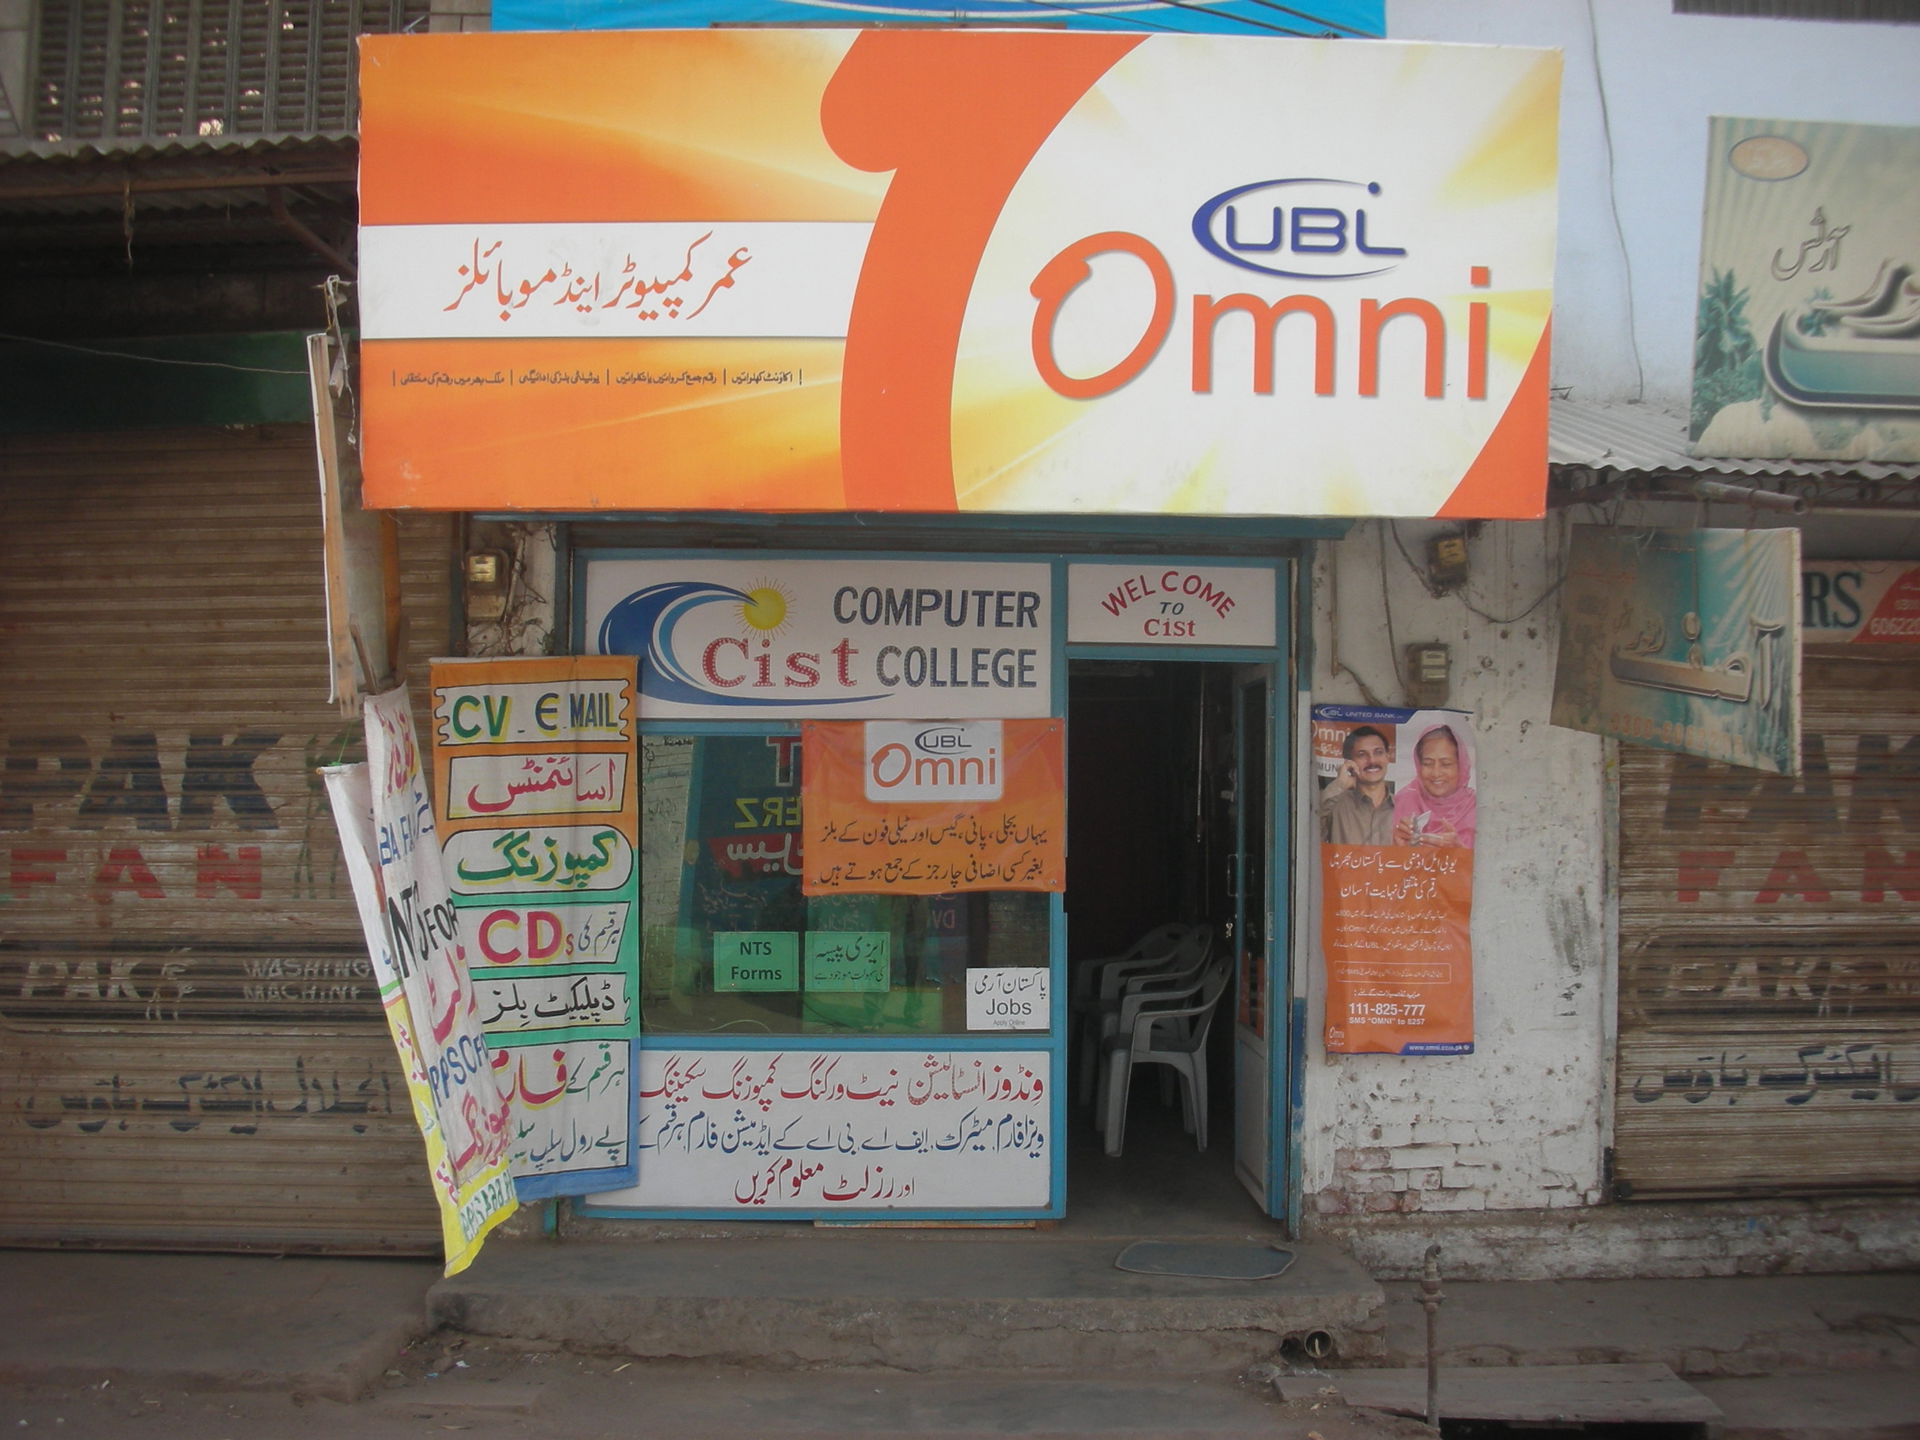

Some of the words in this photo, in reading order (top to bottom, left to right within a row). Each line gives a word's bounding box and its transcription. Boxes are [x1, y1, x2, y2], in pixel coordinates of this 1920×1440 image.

[1226, 205, 1407, 256] UBL
[443, 237, 557, 322] موبائلز
[554, 261, 600, 313] اینڈ
[602, 230, 713, 321] کمپیوٹر
[686, 246, 752, 320] عمر
[1029, 230, 1490, 400] Omni
[833, 587, 1041, 628] COMPUTER
[1101, 571, 1236, 619] WELCOME
[1159, 602, 1185, 616] TO
[1143, 617, 1196, 637] Cist
[702, 637, 860, 688] Cist
[876, 645, 1037, 688] COLLEGE
[452, 694, 510, 739] CV
[923, 735, 972, 749] UBL
[871, 743, 995, 787] Omni
[0, 732, 281, 831] PAK
[820, 820, 838, 843] بلز
[839, 821, 860, 843] کے
[862, 818, 889, 845] فون
[911, 830, 929, 844] اور
[1015, 827, 1048, 845] یہاں
[10, 846, 263, 899] FAN
[819, 864, 841, 887] ہیں
[844, 862, 882, 881] ہوتے
[902, 858, 921, 880] کے
[964, 854, 1000, 882] اضافی
[1677, 851, 1920, 903] FAN
[740, 942, 772, 956] NTS
[730, 965, 782, 980] Forms
[974, 972, 1004, 995] آرمی
[1002, 970, 1047, 1000] پاکستان
[985, 998, 1032, 1015] Jobs
[1348, 1002, 1426, 1016] 111-825-777
[846, 1068, 899, 1106] نیٹ
[986, 1061, 1045, 1107] ونڈوز
[773, 1114, 806, 1151] کے
[806, 1124, 837, 1151] اے
[861, 1126, 894, 1151] اے
[895, 1127, 928, 1154] ایف
[734, 1155, 784, 1205] کریں
[778, 1157, 825, 1200] معلوم
[897, 1177, 915, 1198] اور
